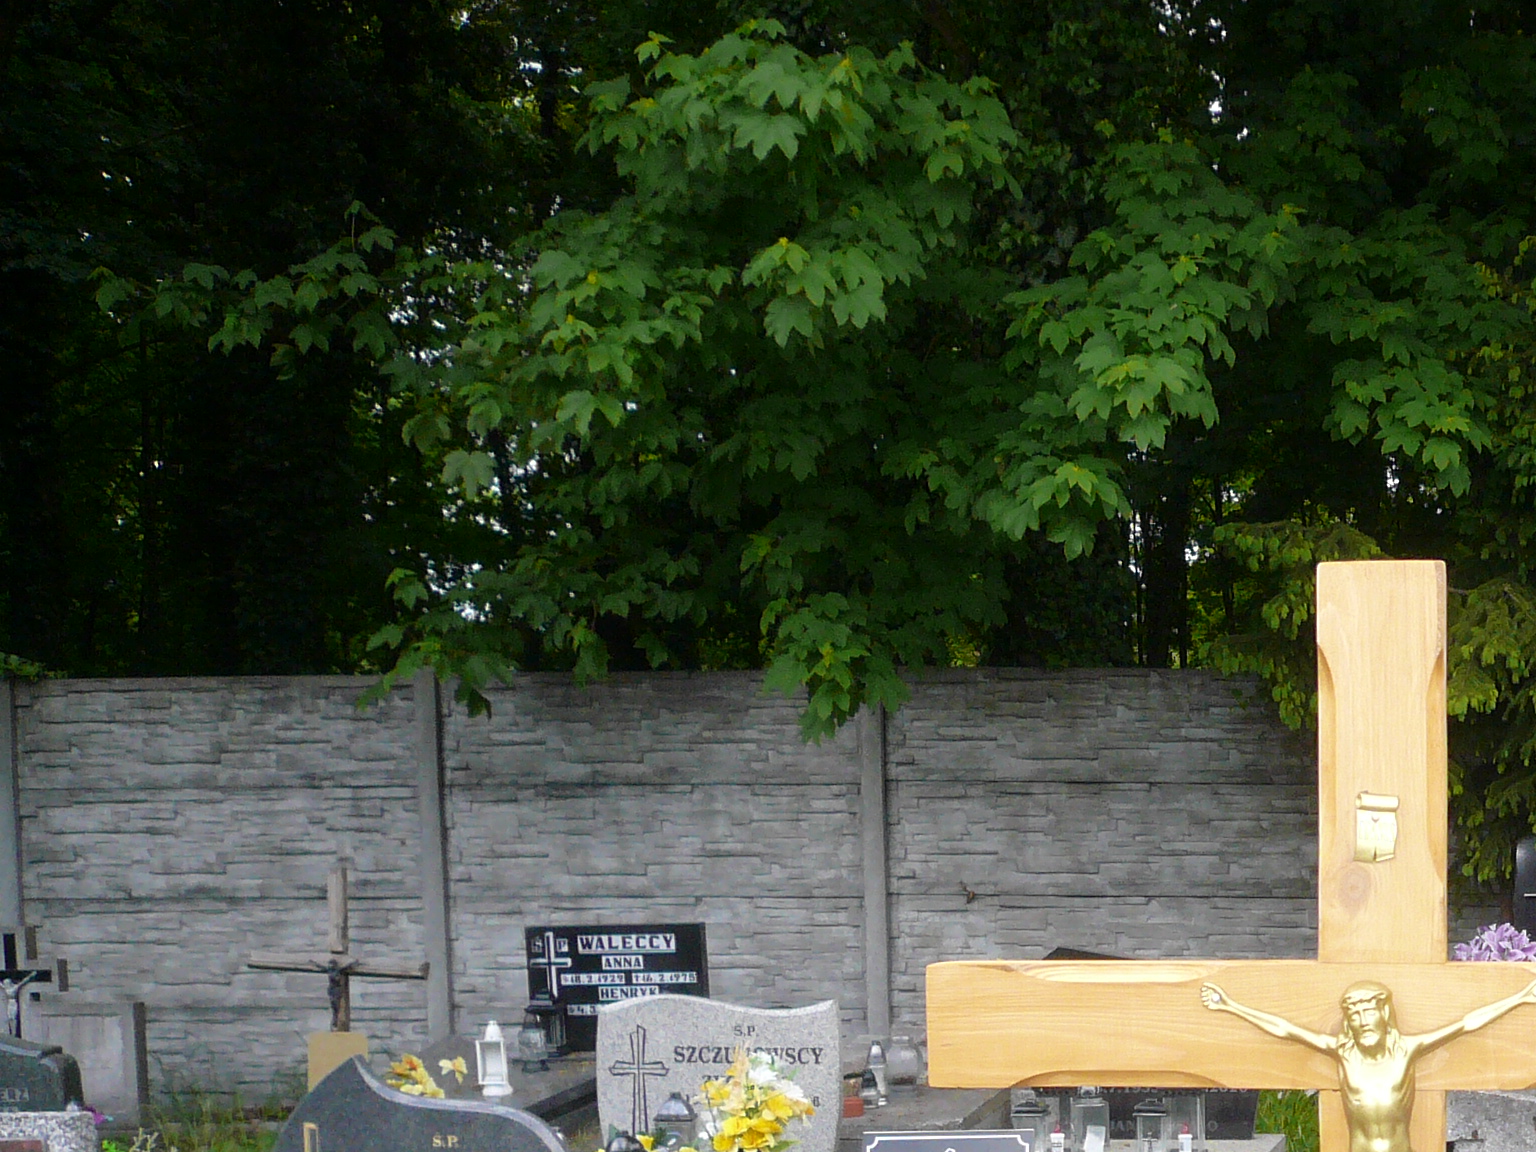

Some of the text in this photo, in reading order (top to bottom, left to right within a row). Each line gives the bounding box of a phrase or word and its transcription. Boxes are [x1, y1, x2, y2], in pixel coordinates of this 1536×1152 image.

[579, 935, 675, 951] WALECCY
[603, 957, 643, 969] ANNA
[600, 986, 659, 999] HENRYK
